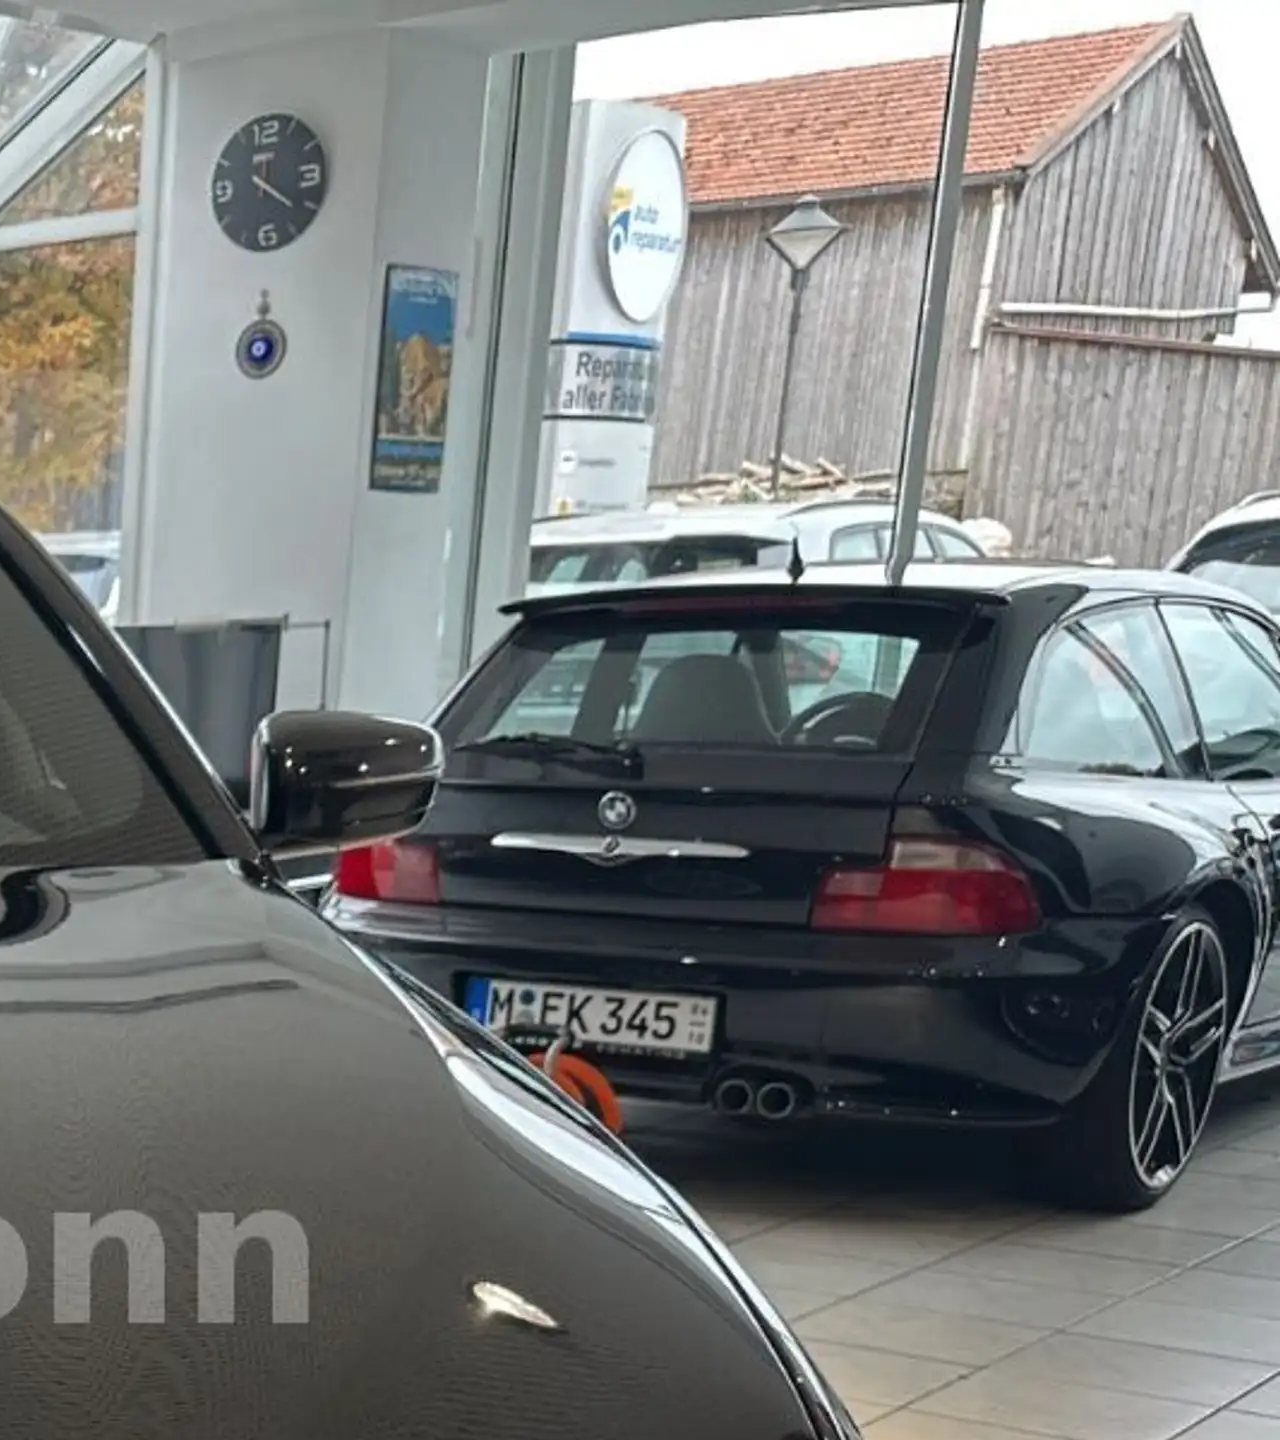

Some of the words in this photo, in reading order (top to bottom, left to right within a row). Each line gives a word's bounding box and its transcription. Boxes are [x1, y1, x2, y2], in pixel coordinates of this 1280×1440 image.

[253, 120, 280, 147] 12
[298, 163, 321, 189] 3
[215, 179, 234, 203] 9
[634, 204, 660, 225] auto
[258, 223, 278, 247] 6
[562, 382, 607, 411] aller
[490, 986, 515, 1025] M
[599, 996, 680, 1041] 345
